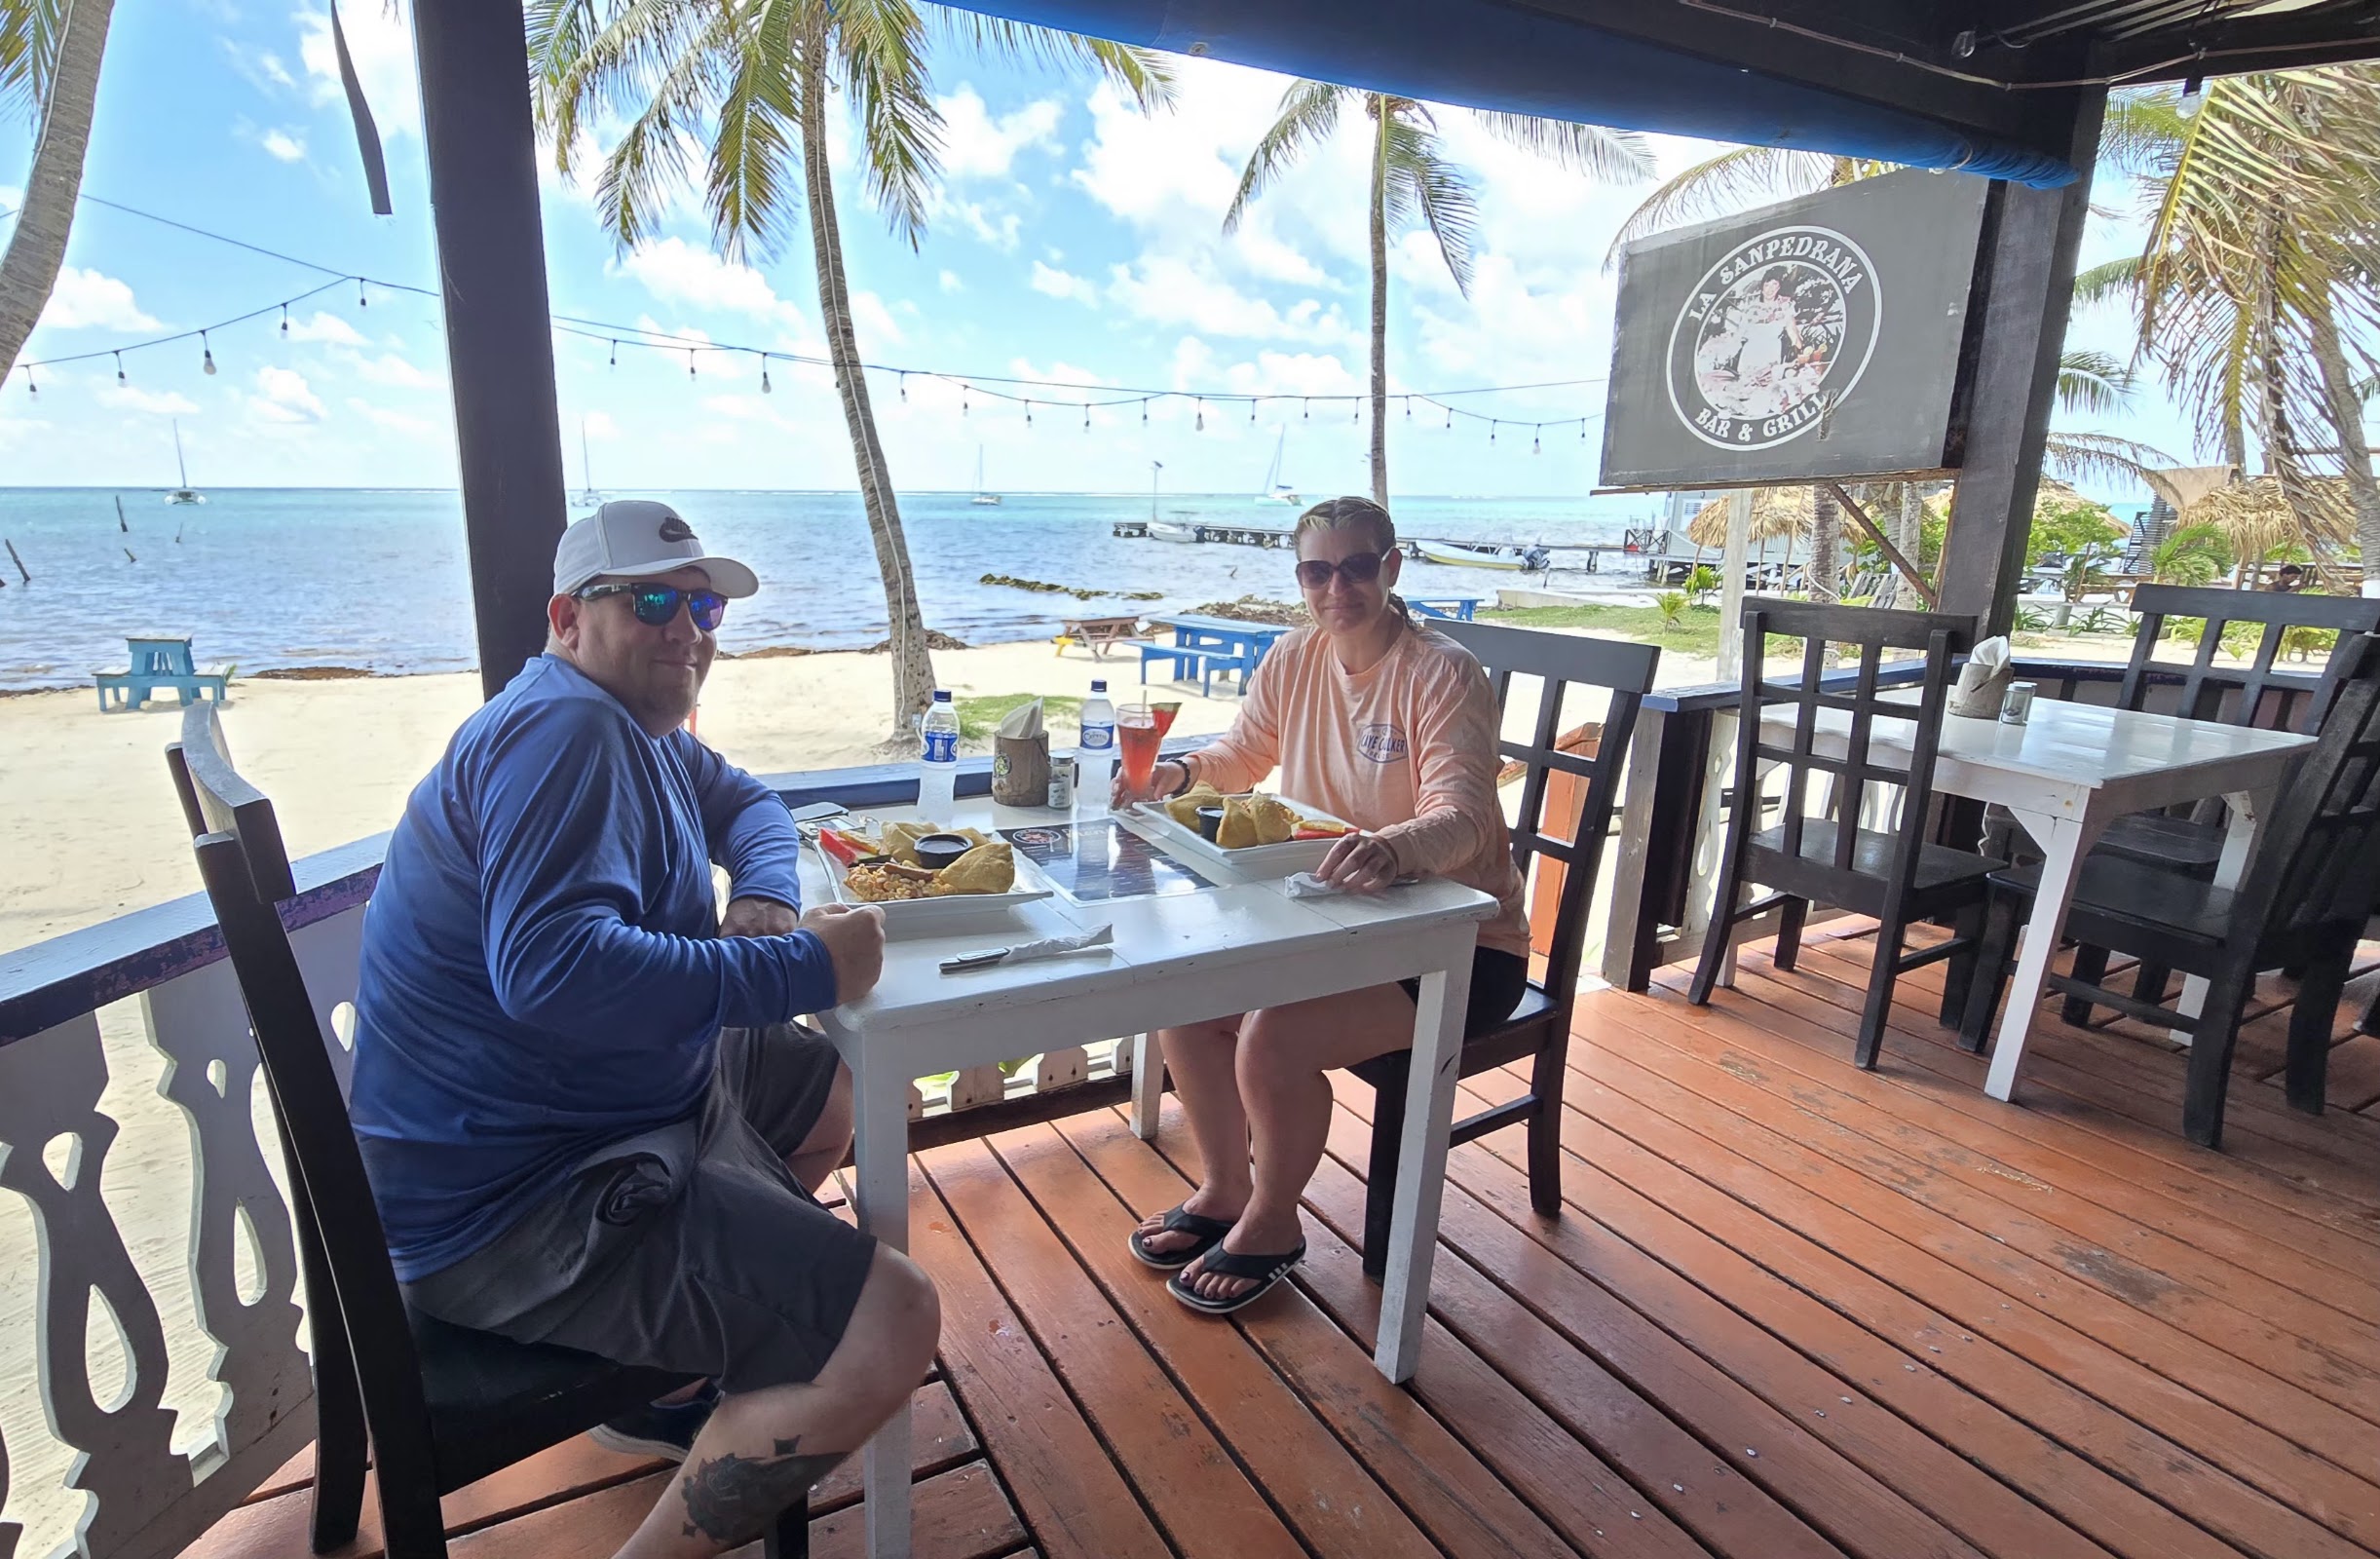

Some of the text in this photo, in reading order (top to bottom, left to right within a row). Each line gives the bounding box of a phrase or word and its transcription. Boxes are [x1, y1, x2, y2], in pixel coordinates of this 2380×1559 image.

[1688, 236, 1864, 322] LA SANPEDRANA
[1695, 393, 1828, 442] BAR & GRILL
